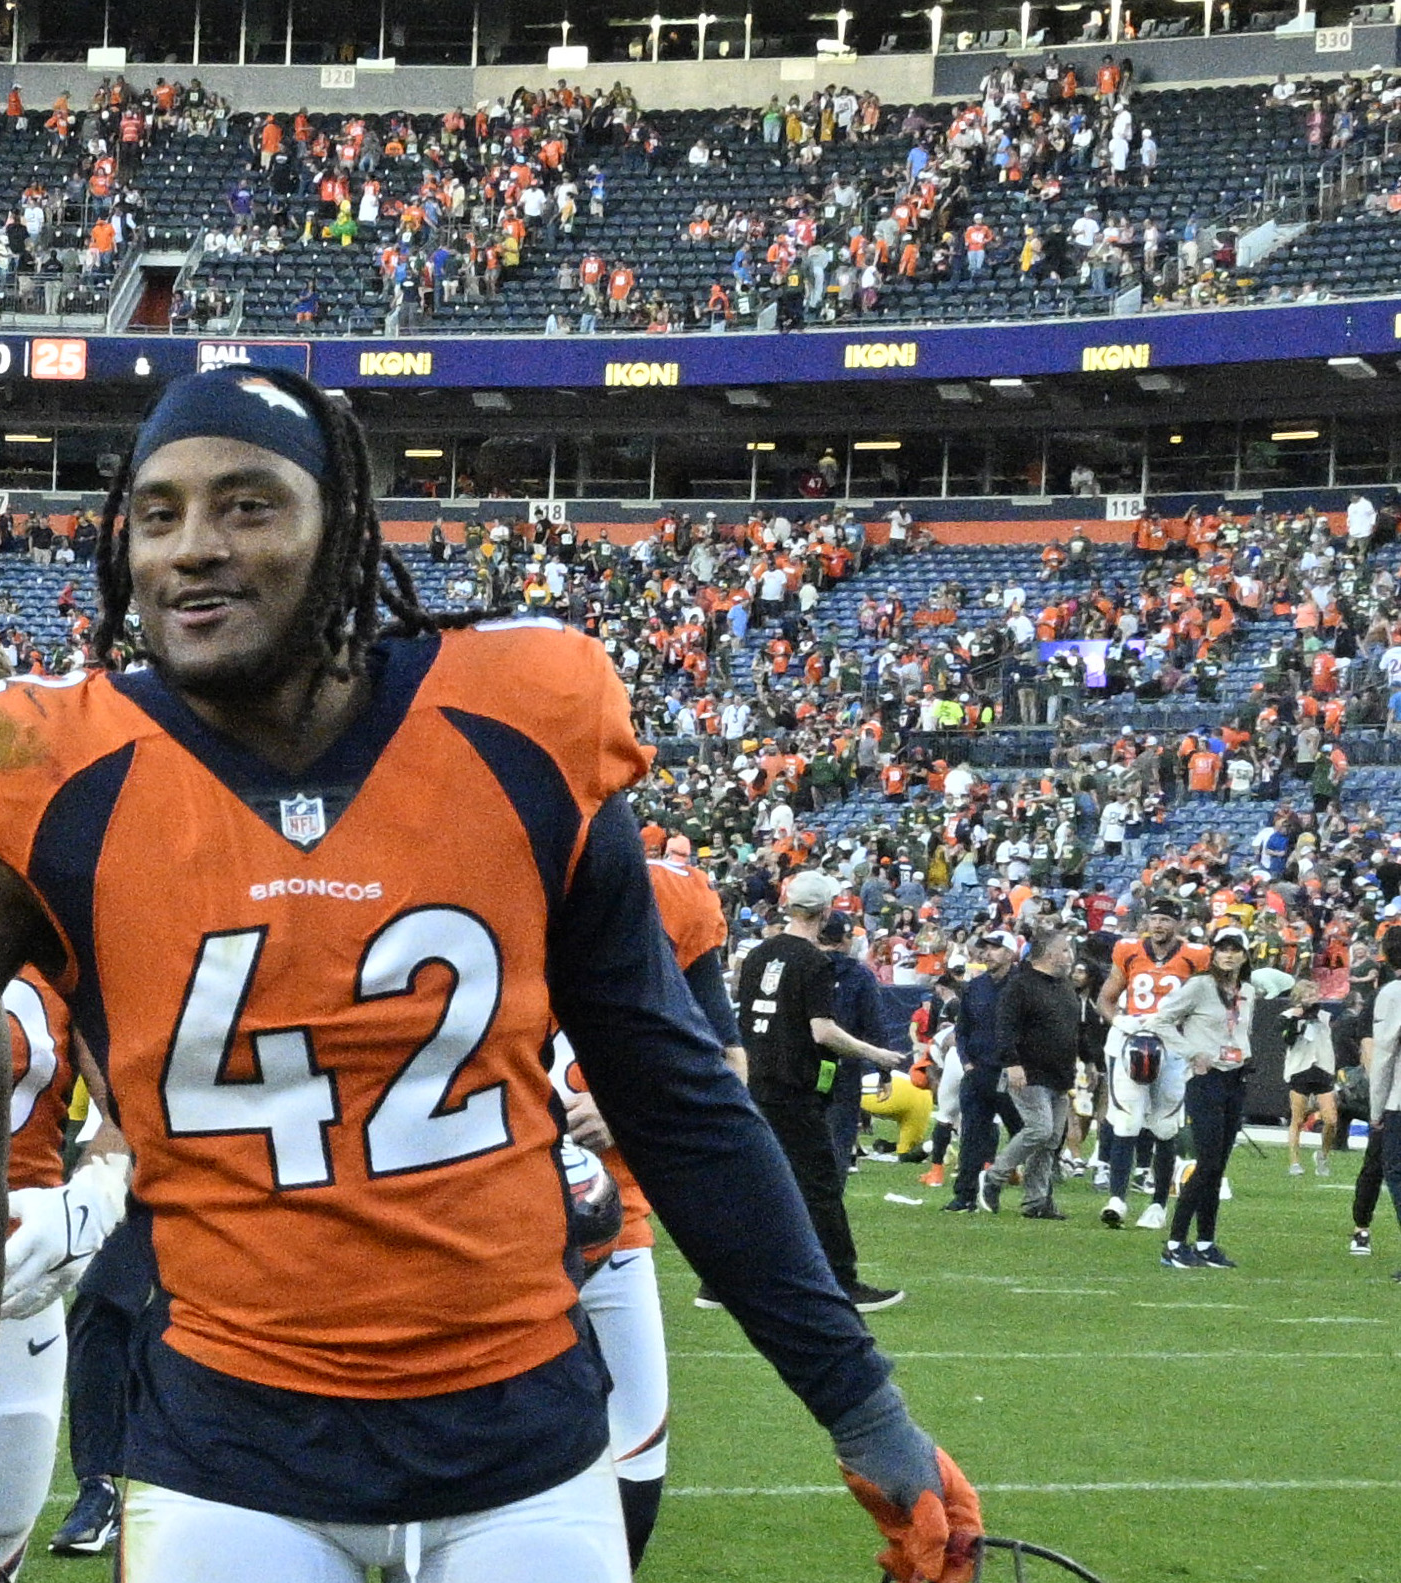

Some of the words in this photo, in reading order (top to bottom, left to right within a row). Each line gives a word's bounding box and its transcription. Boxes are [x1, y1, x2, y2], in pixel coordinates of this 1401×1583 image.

[1317, 29, 1349, 48] 330
[322, 68, 354, 87] 328
[34, 343, 84, 375] 25
[201, 345, 251, 363] BALL
[360, 351, 419, 376] IKON
[845, 342, 910, 368] IKON
[1082, 344, 1142, 372] IKON
[605, 363, 670, 386] IKON
[1112, 501, 1140, 516] 118
[249, 877, 382, 901] BRONCOS
[1133, 973, 1182, 1011] 82
[159, 903, 513, 1192] 42
